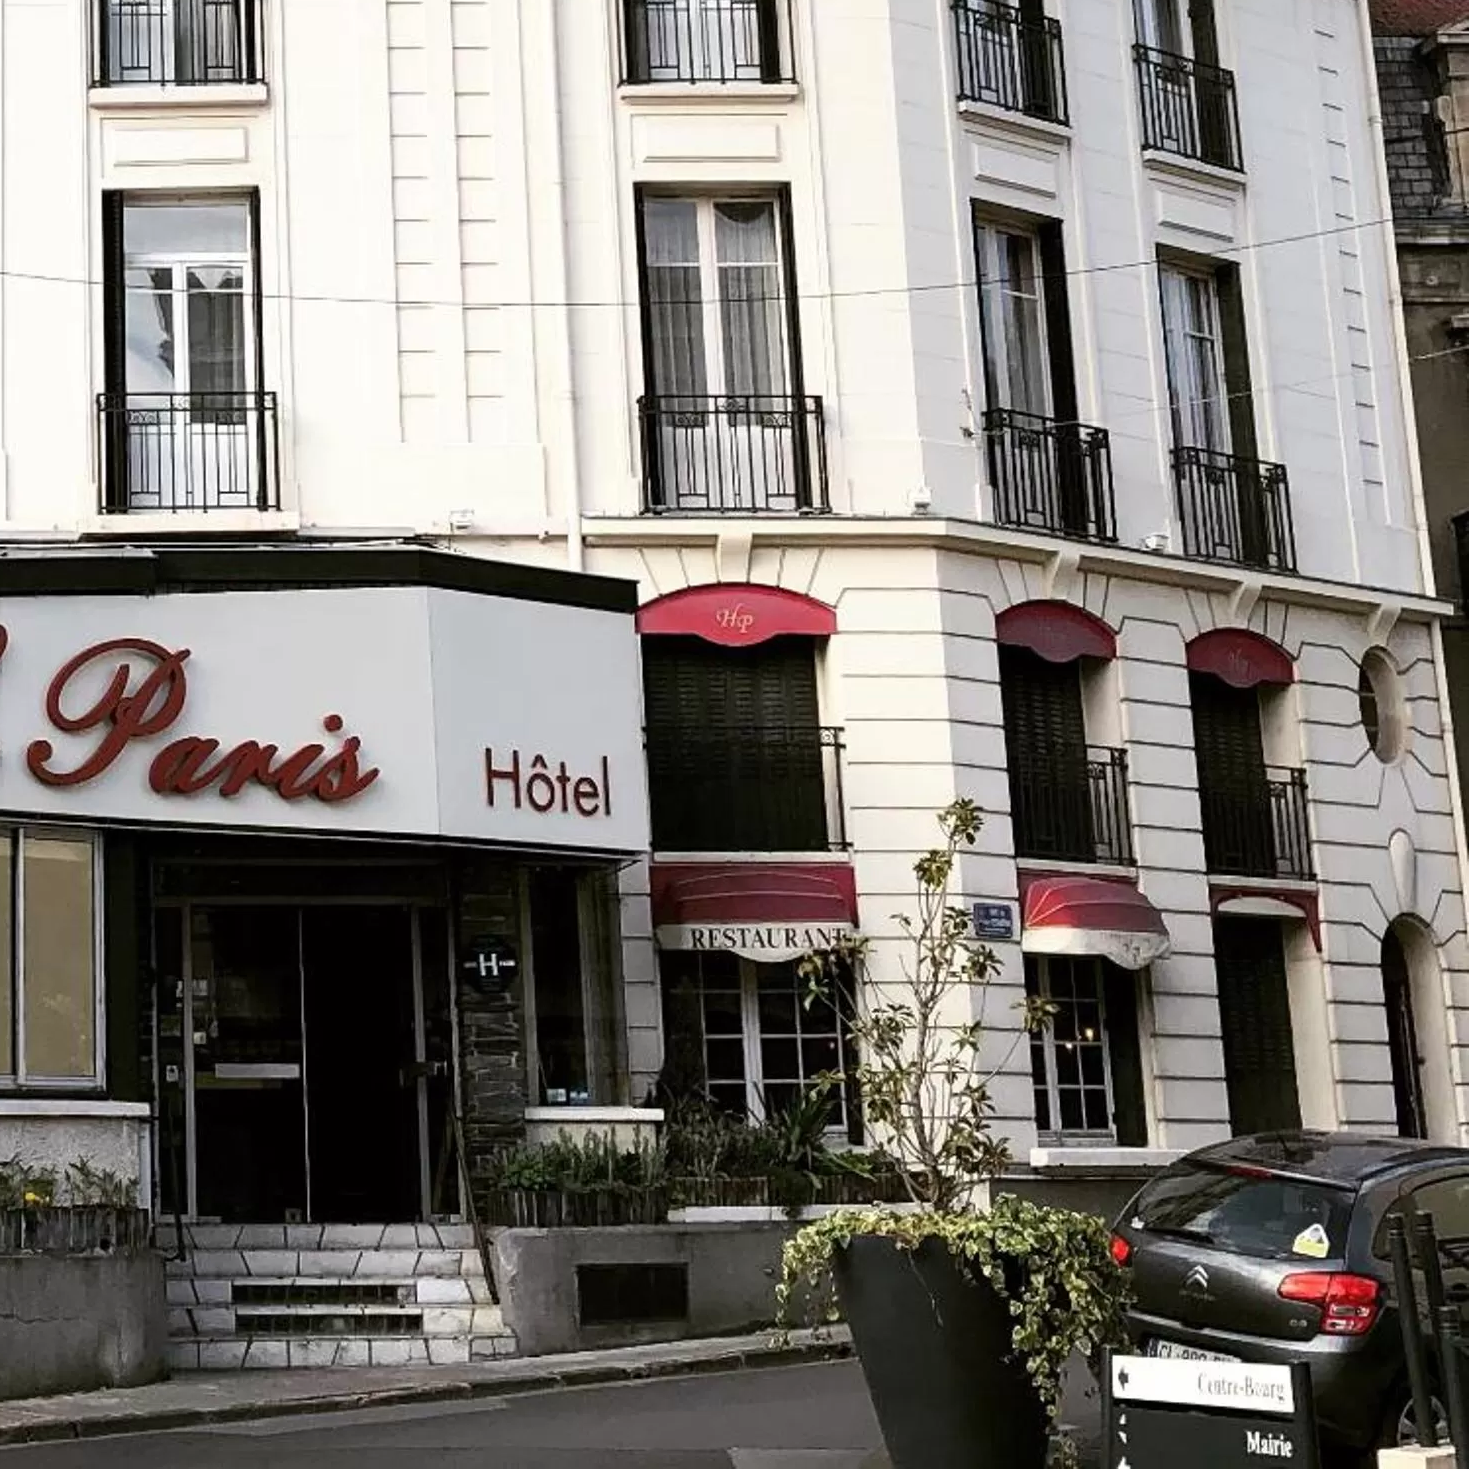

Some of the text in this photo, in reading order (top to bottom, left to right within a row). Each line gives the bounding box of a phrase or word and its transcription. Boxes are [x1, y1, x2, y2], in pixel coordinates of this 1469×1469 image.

[26, 637, 381, 802] Paris
[485, 747, 612, 817] Hôtel
[691, 927, 847, 949] RESTAURANT
[478, 953, 499, 977] H
[1197, 1372, 1286, 1402] Centre-Bourg
[1245, 1430, 1294, 1458] Mairie
